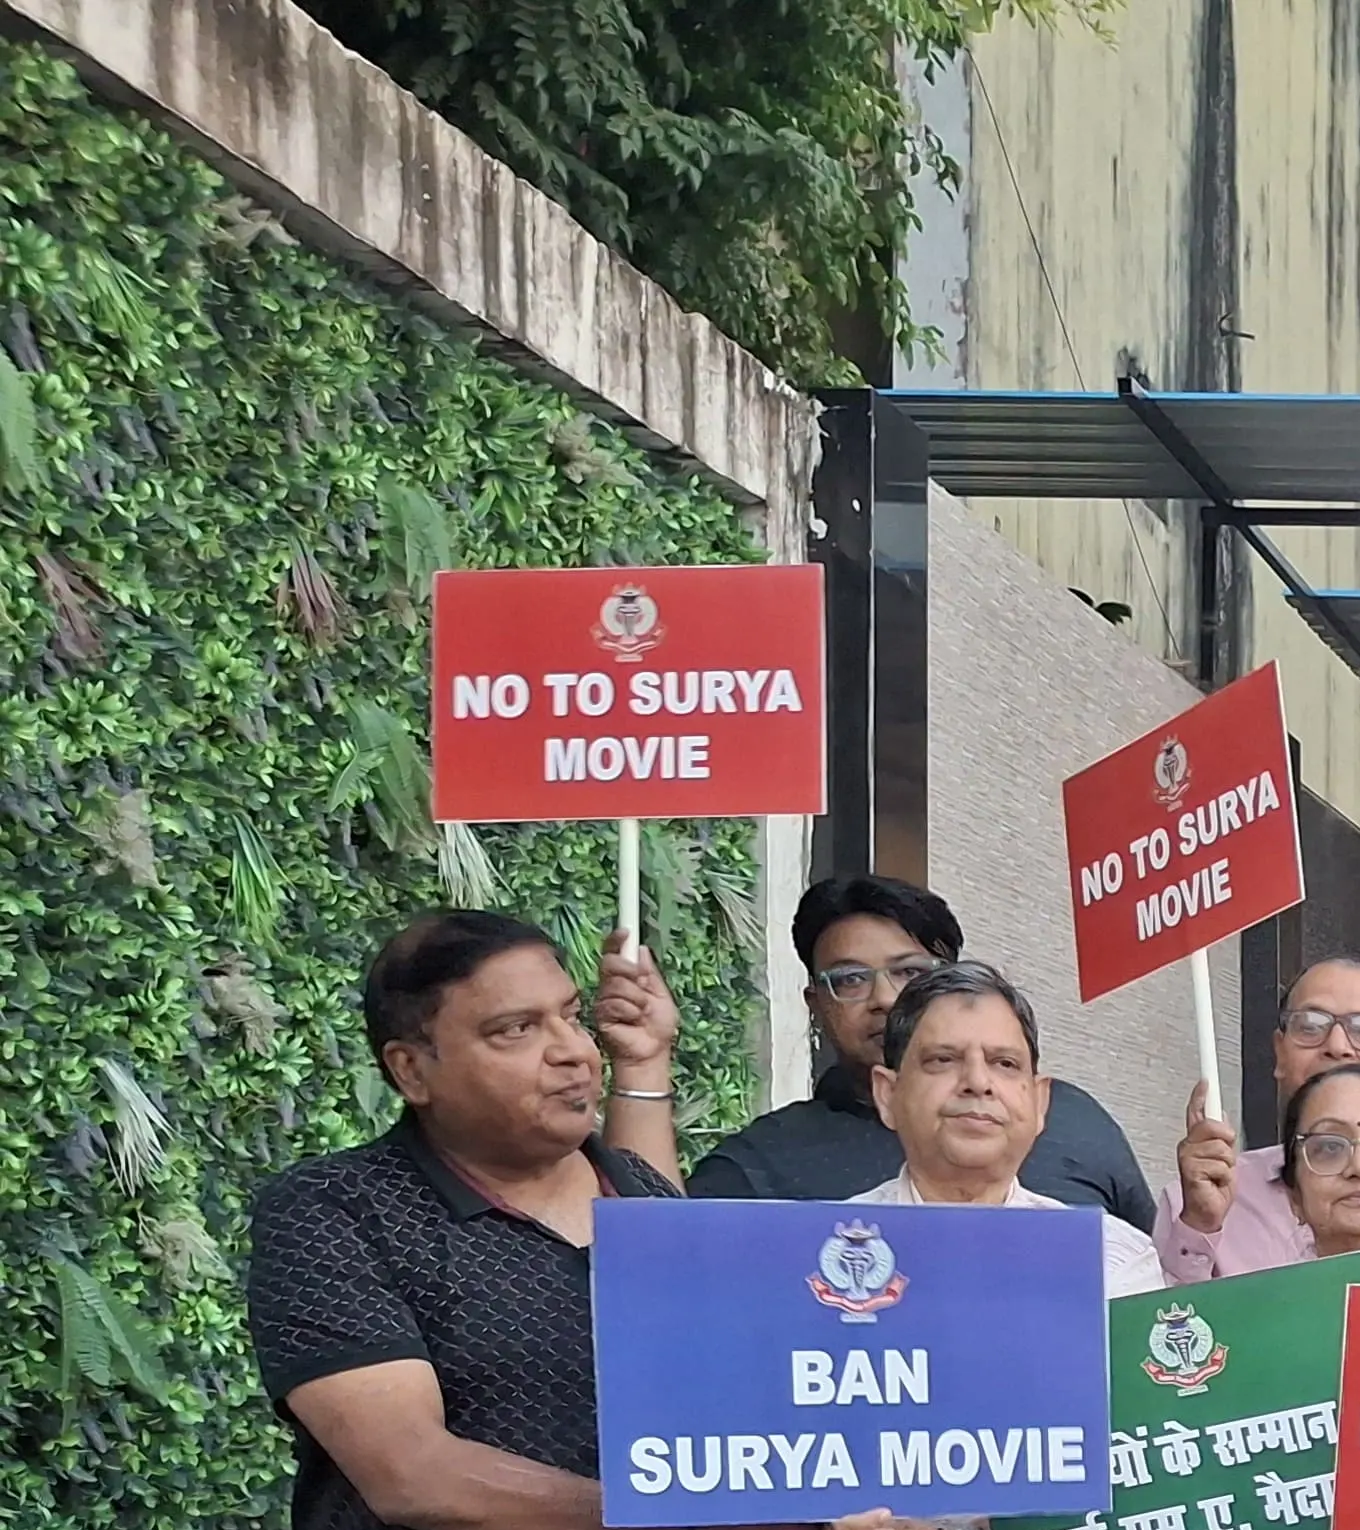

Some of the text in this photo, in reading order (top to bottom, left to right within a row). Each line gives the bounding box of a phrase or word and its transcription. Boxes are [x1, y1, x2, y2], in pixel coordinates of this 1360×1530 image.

[452, 670, 802, 719] NO TO SURYA
[544, 735, 711, 781] MOVIE
[1080, 770, 1280, 906] NO TO SURYA
[1135, 868, 1232, 942] MOVIE
[791, 1348, 929, 1405] BAN
[628, 1431, 861, 1495] SURYA
[880, 1426, 1087, 1486] MOVIE
[1152, 1421, 1201, 1476] के
[1205, 1401, 1337, 1467] सम्मान
[1253, 1471, 1336, 1526] मैदा
